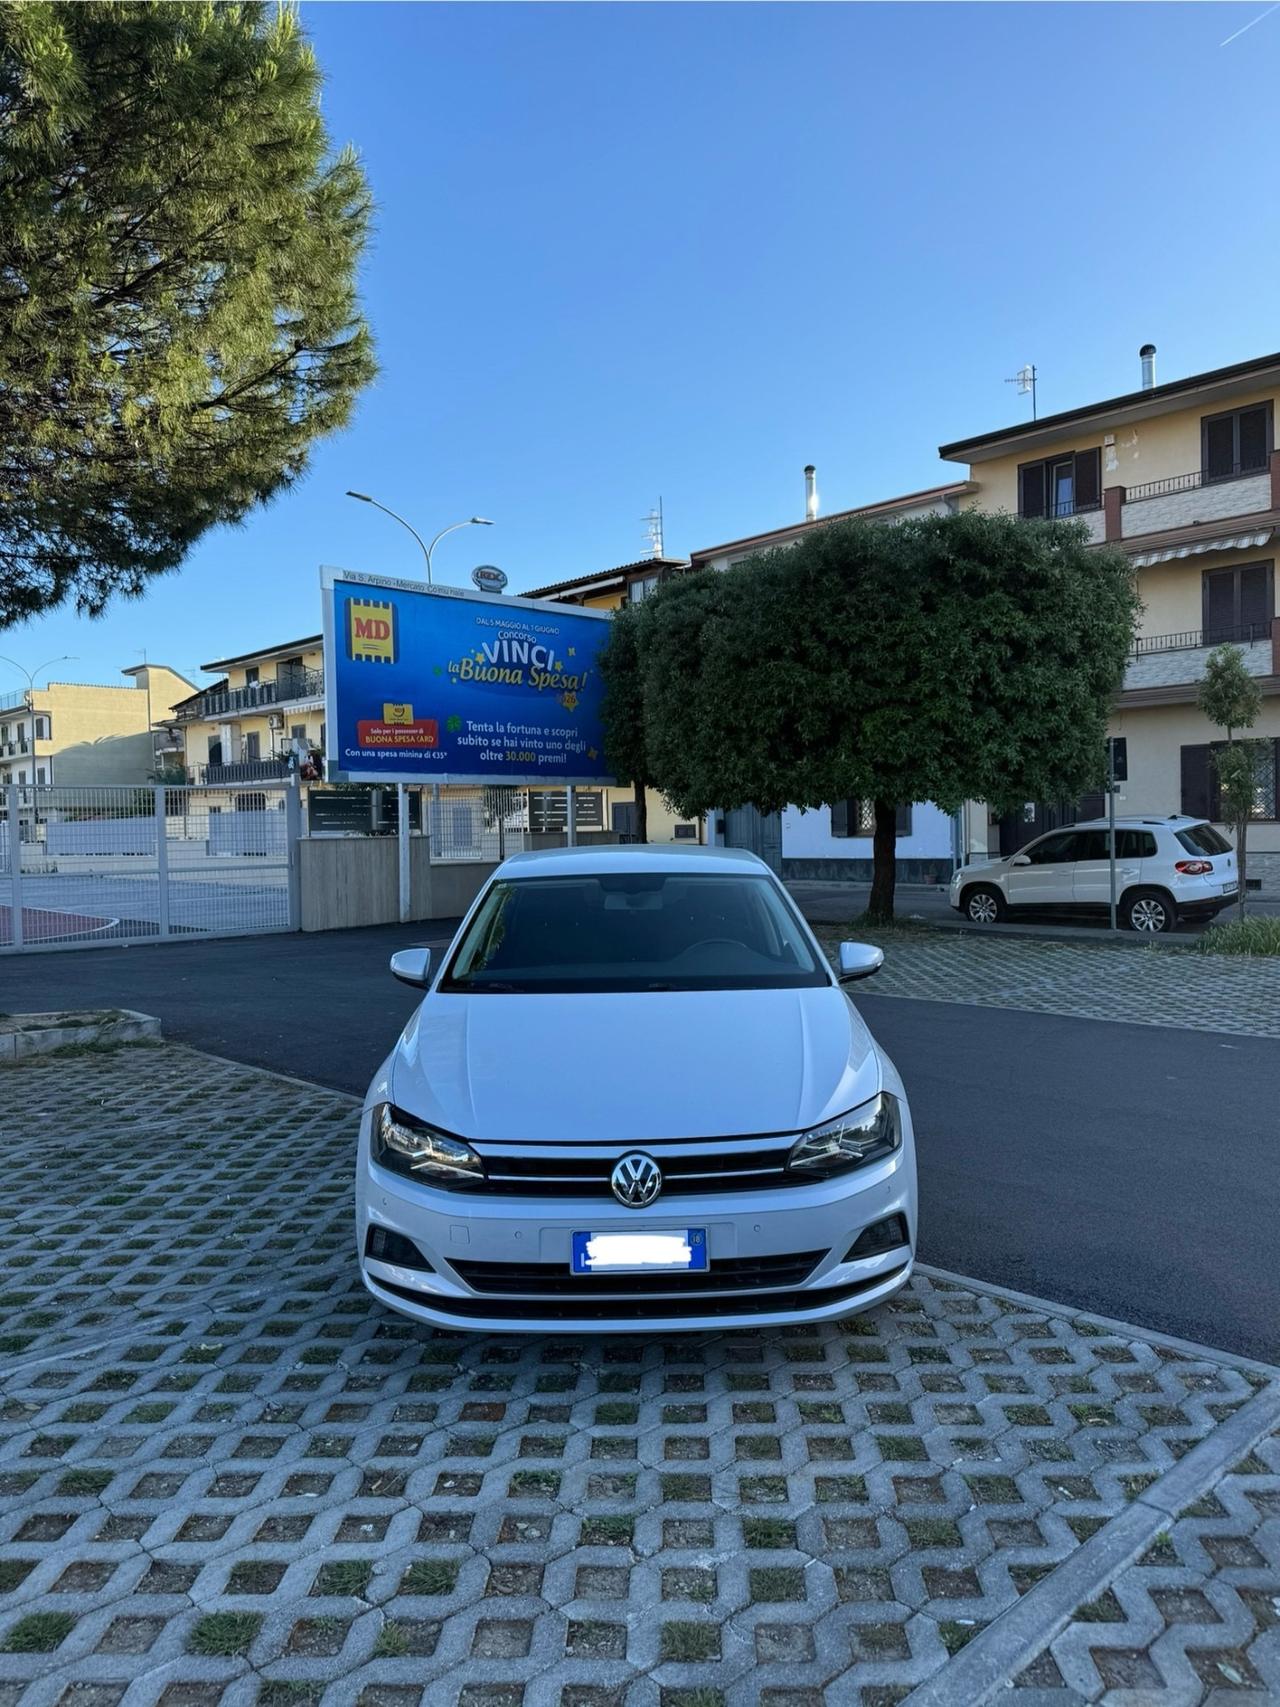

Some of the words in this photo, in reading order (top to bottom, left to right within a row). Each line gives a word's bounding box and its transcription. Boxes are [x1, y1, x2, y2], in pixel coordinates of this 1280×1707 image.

[343, 570, 357, 581] Via
[367, 575, 392, 587] Arpino
[354, 616, 390, 641] MD
[476, 617, 489, 626] DAL
[495, 619, 520, 630] MAGGIO
[521, 623, 530, 631] AL
[534, 625, 560, 635] GIUGNO
[498, 630, 537, 644] Concorso
[482, 640, 555, 671] VINCI
[448, 660, 460, 673] la
[460, 658, 523, 685] Buona
[528, 666, 588, 691] Spesa!
[466, 720, 494, 732] Tenta
[496, 722, 505, 733] la
[507, 722, 541, 736] fortuna
[543, 728, 551, 736] e
[551, 727, 578, 739] scopri
[416, 735, 434, 743] CARD
[457, 734, 489, 746] subito
[491, 738, 502, 747] se
[503, 736, 518, 748] hai
[520, 738, 544, 749] vinto
[545, 741, 563, 750] uno
[565, 740, 587, 754] degli
[345, 748, 360, 757] Con
[377, 751, 398, 760] spesa
[423, 750, 431, 758] di
[480, 749, 504, 761] oltre
[505, 751, 536, 762] 30.000
[538, 753, 567, 765] premi!
[611, 1153, 662, 1207] VW
